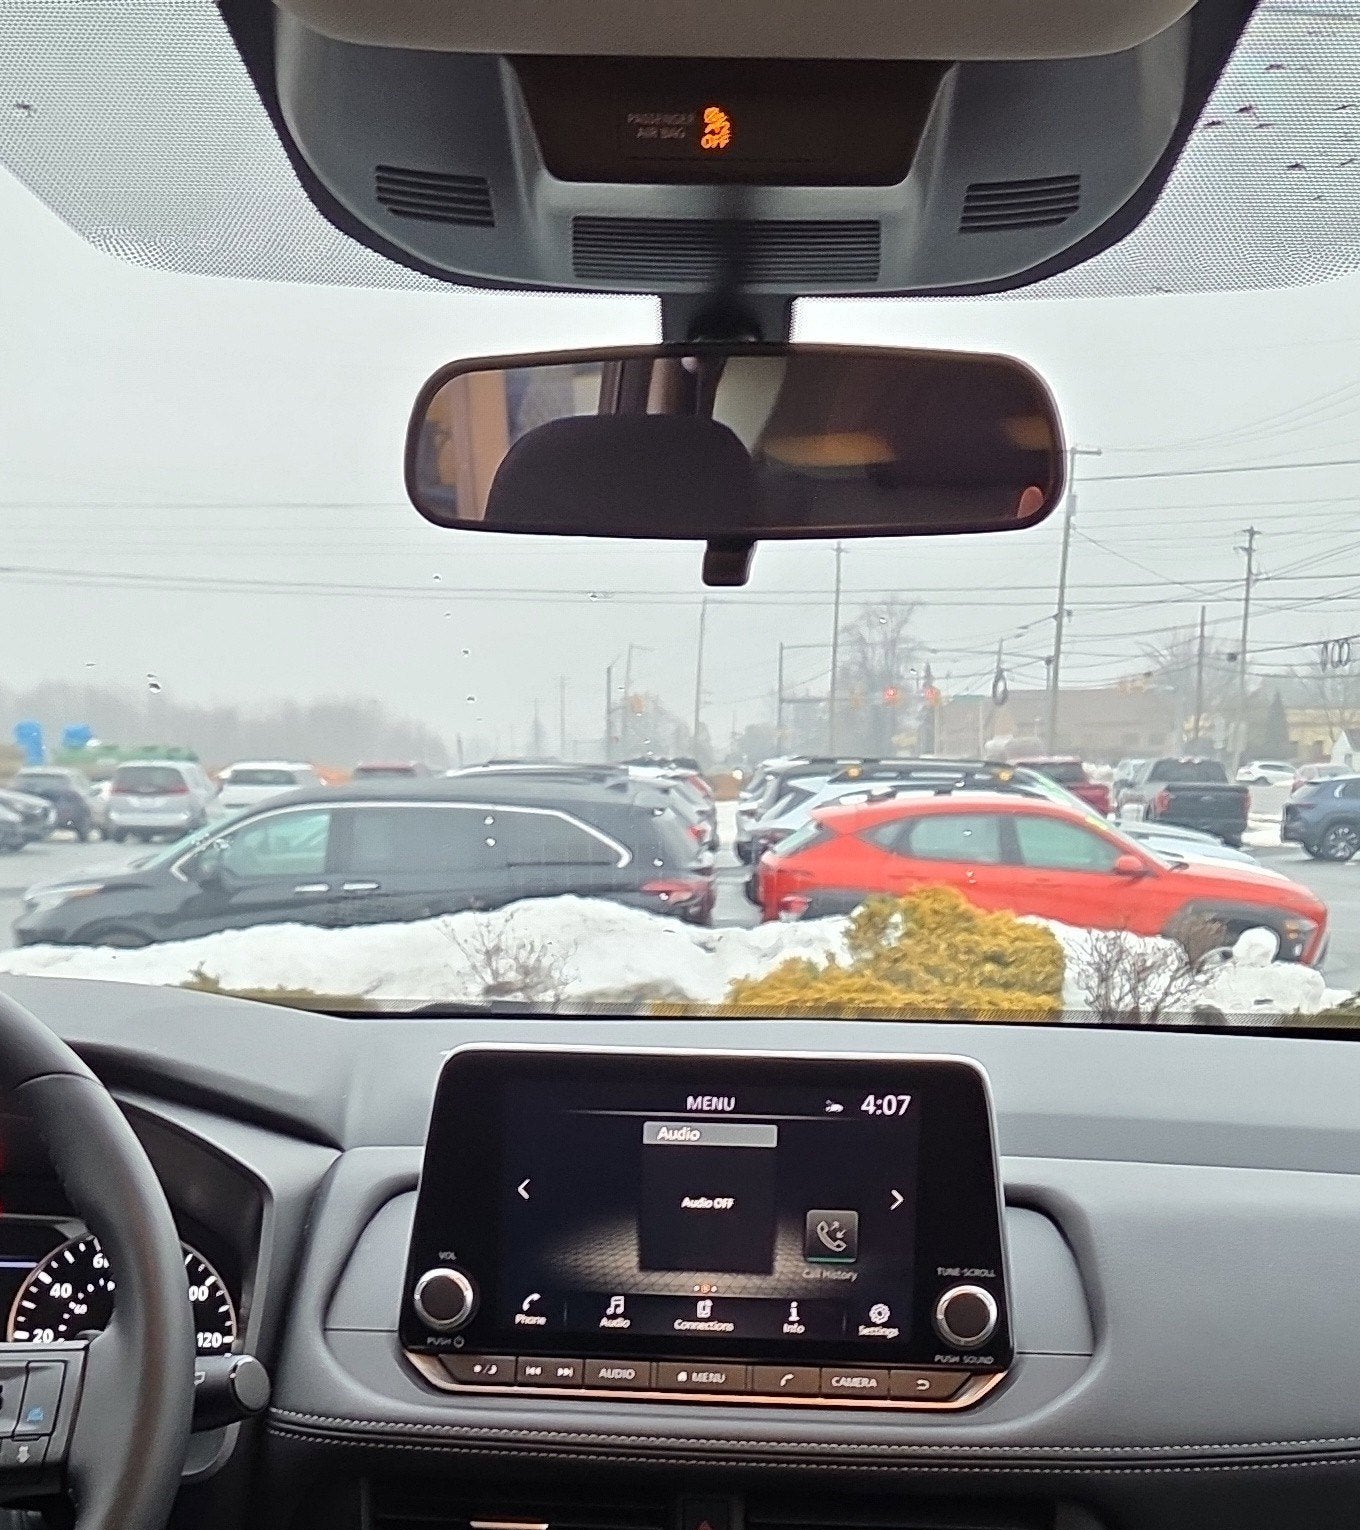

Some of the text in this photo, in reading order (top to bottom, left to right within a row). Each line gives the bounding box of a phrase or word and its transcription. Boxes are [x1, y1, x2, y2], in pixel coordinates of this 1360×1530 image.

[686, 1096, 736, 1112] MENU
[860, 1094, 912, 1116] 4:07
[656, 1126, 701, 1142] Audio
[681, 1197, 713, 1209] Audio
[438, 1251, 457, 1261] VOL
[822, 1270, 858, 1283] History
[49, 1282, 73, 1299] 40
[514, 1313, 547, 1326] Phone
[599, 1317, 631, 1328] Audio
[673, 1319, 735, 1332] Connections
[782, 1323, 806, 1334] Info
[858, 1325, 900, 1339] Settings
[32, 1328, 54, 1343] 20
[196, 1332, 223, 1348] 120
[598, 1368, 636, 1380] AUDIO
[691, 1371, 727, 1384] MENU
[831, 1376, 878, 1388] CAMERA
